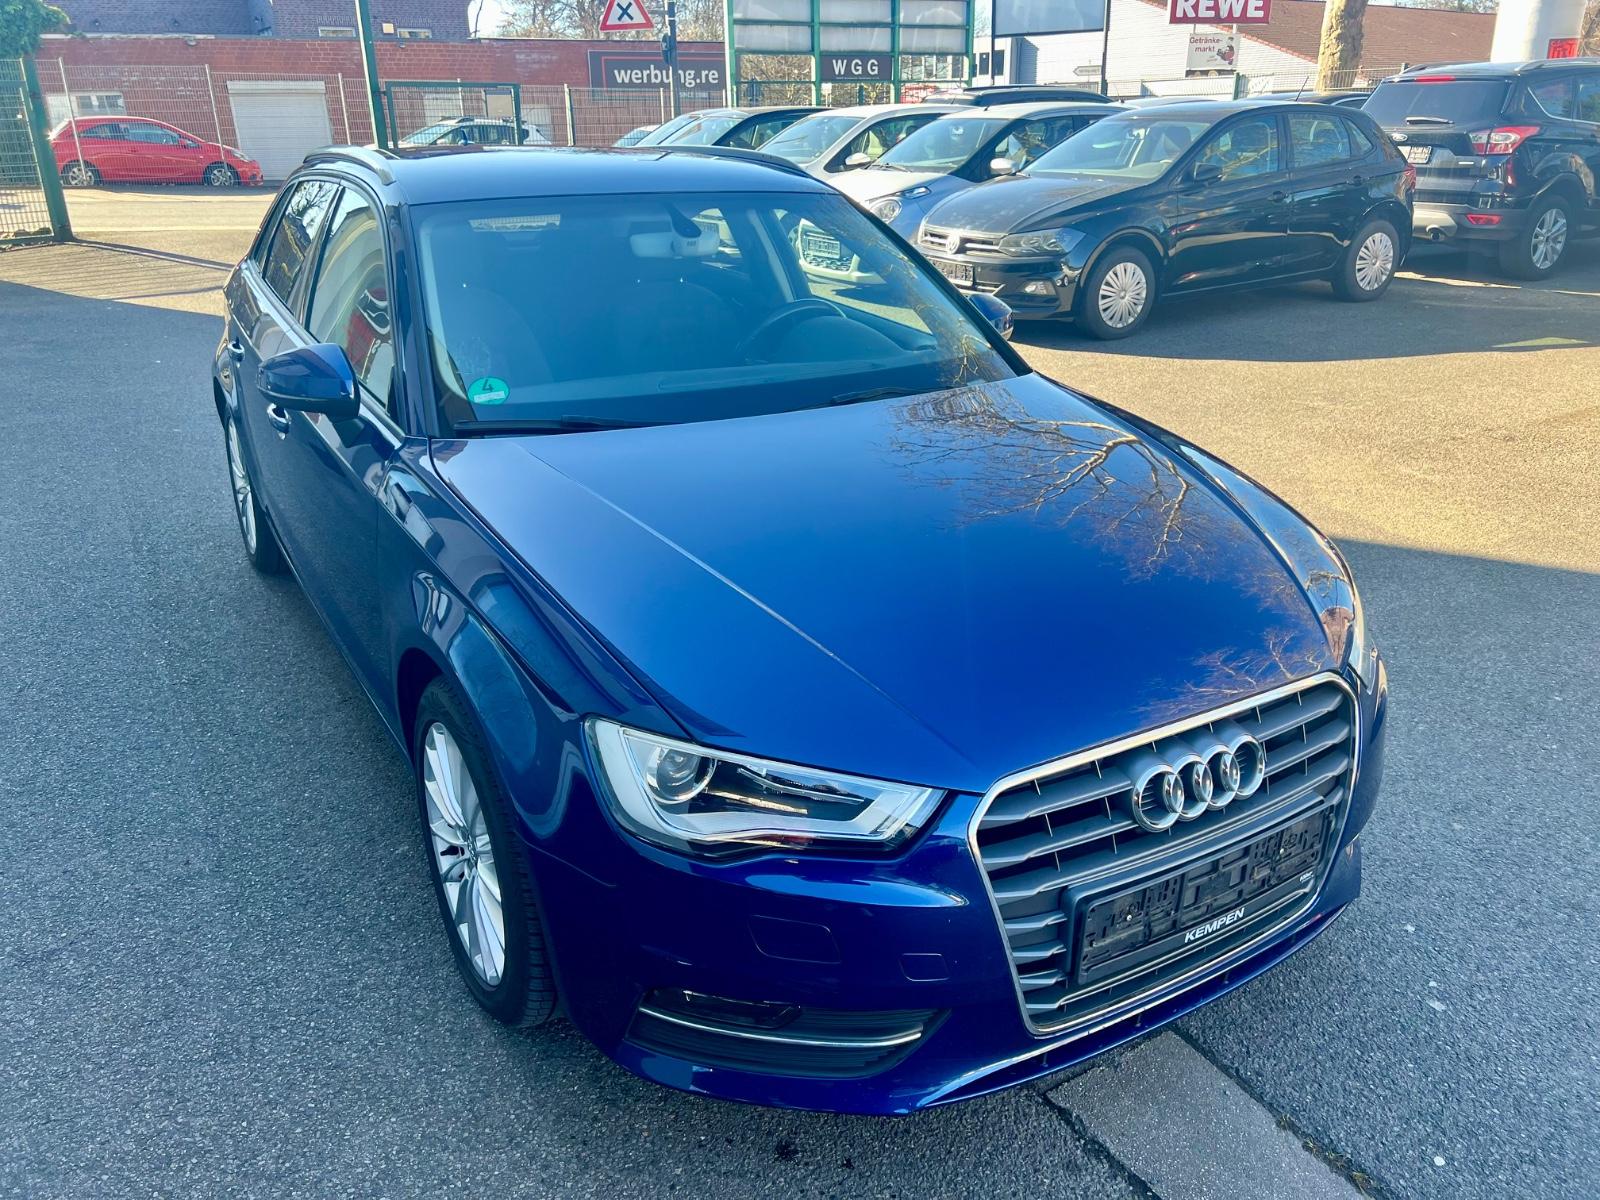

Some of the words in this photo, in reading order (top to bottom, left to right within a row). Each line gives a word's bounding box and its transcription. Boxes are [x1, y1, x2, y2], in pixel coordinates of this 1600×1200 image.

[1176, 0, 1264, 18] REWE
[482, 379, 494, 392] 4
[1184, 907, 1245, 943] KEMPEN
